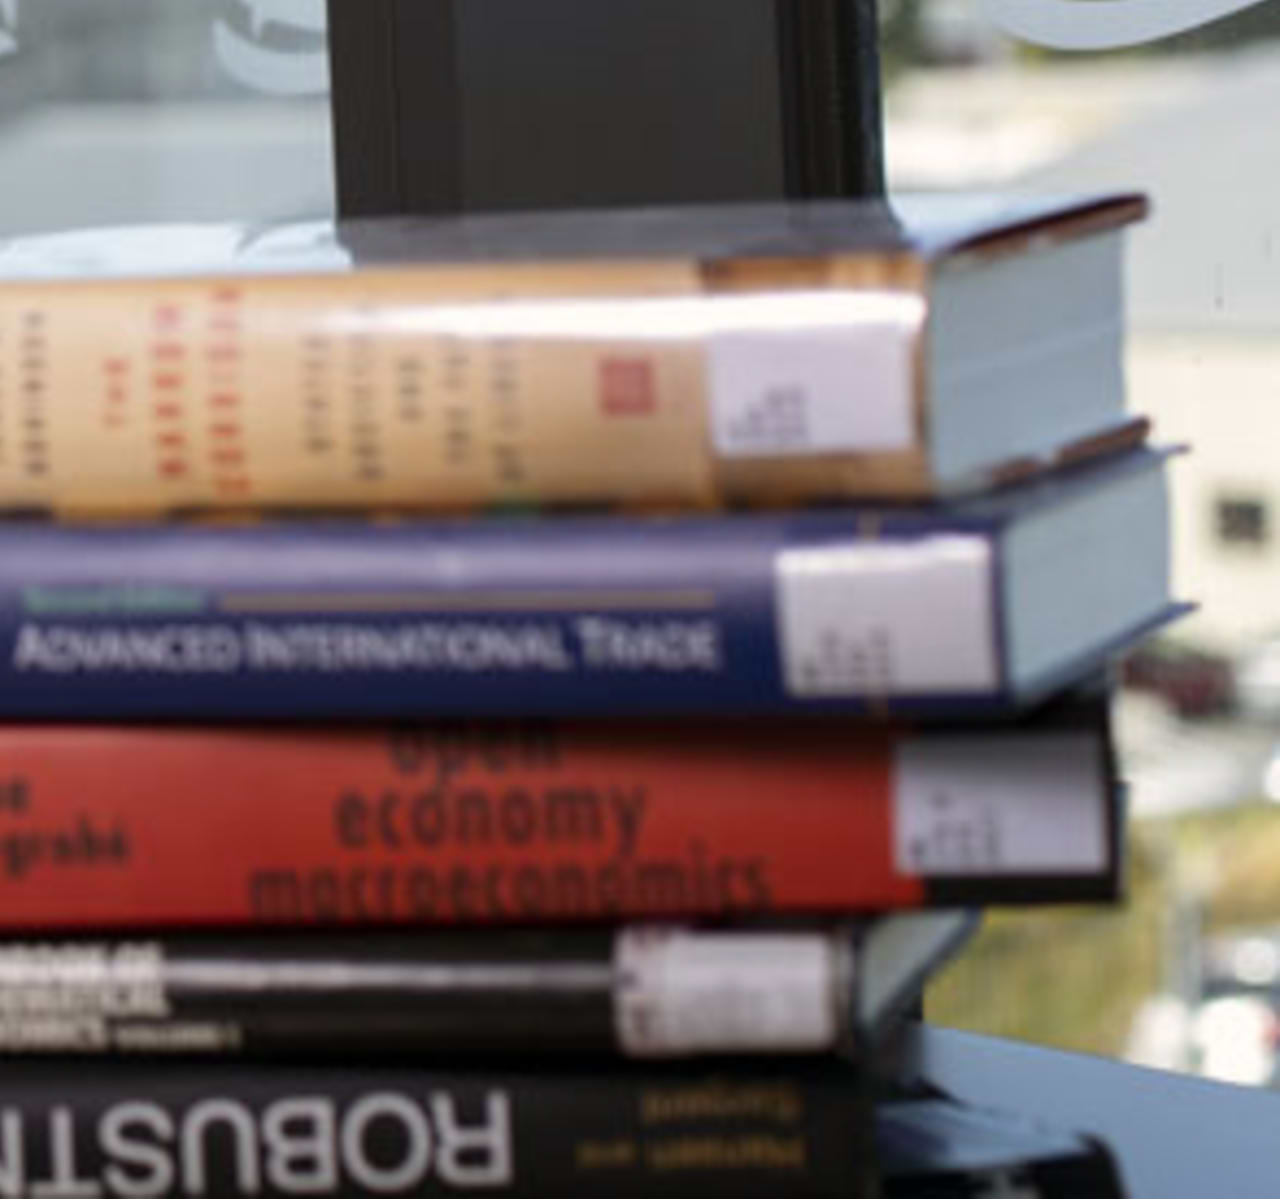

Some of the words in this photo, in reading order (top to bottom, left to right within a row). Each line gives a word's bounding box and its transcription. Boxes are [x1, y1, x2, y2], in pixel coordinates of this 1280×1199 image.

[13, 625, 237, 672] ADVANCED
[250, 622, 569, 671] INTERNATIONAL
[578, 615, 723, 669] TRADE
[388, 720, 562, 788] open
[332, 783, 649, 855] economy
[248, 840, 773, 921] macroeconomics
